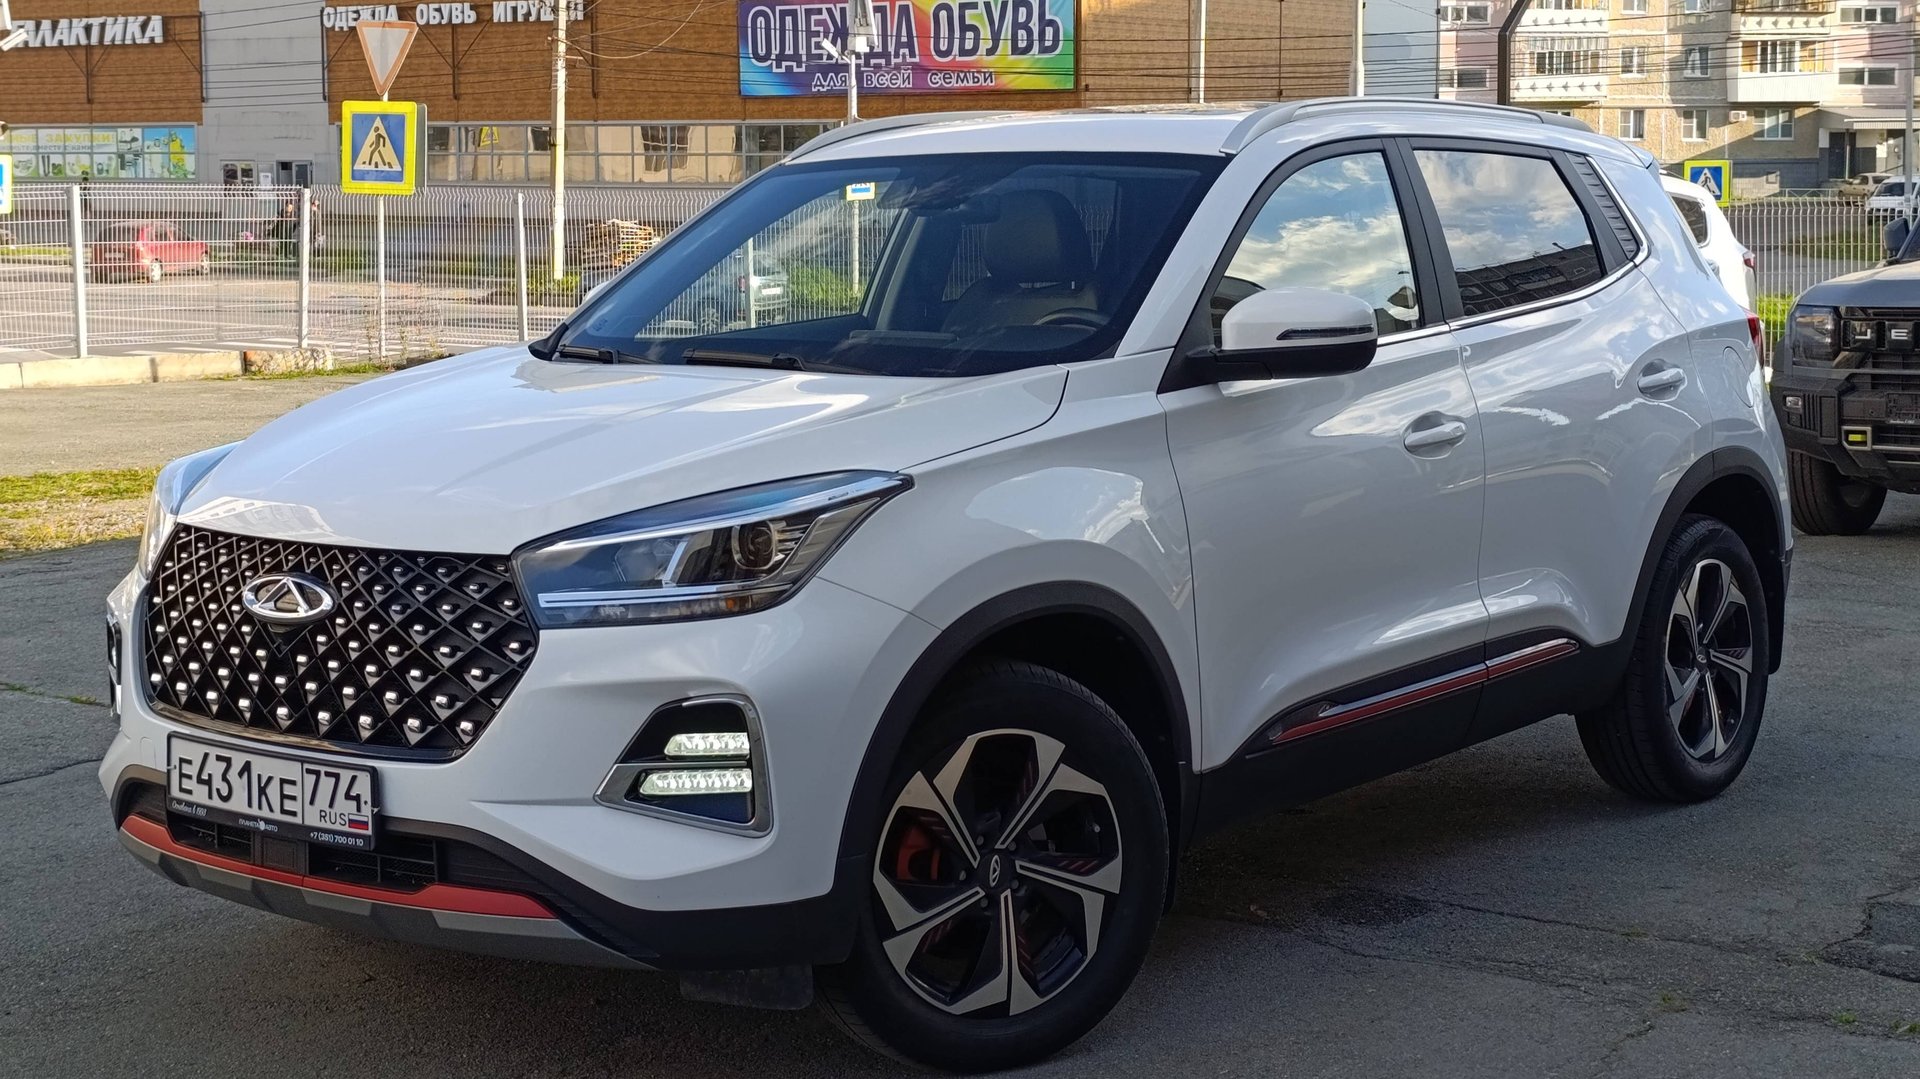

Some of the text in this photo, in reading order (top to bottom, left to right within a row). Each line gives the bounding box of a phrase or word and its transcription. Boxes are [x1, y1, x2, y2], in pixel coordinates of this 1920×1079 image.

[416, 3, 477, 25] ОБУВЬ
[492, 0, 584, 22] ИГРУШИ
[930, 0, 1064, 62] ОБУВЬ
[812, 66, 995, 92] для всей семьи
[178, 751, 298, 817] Е431КЕ
[305, 767, 361, 813] 774
[319, 809, 347, 827] RUS
[334, 834, 347, 844] 700
